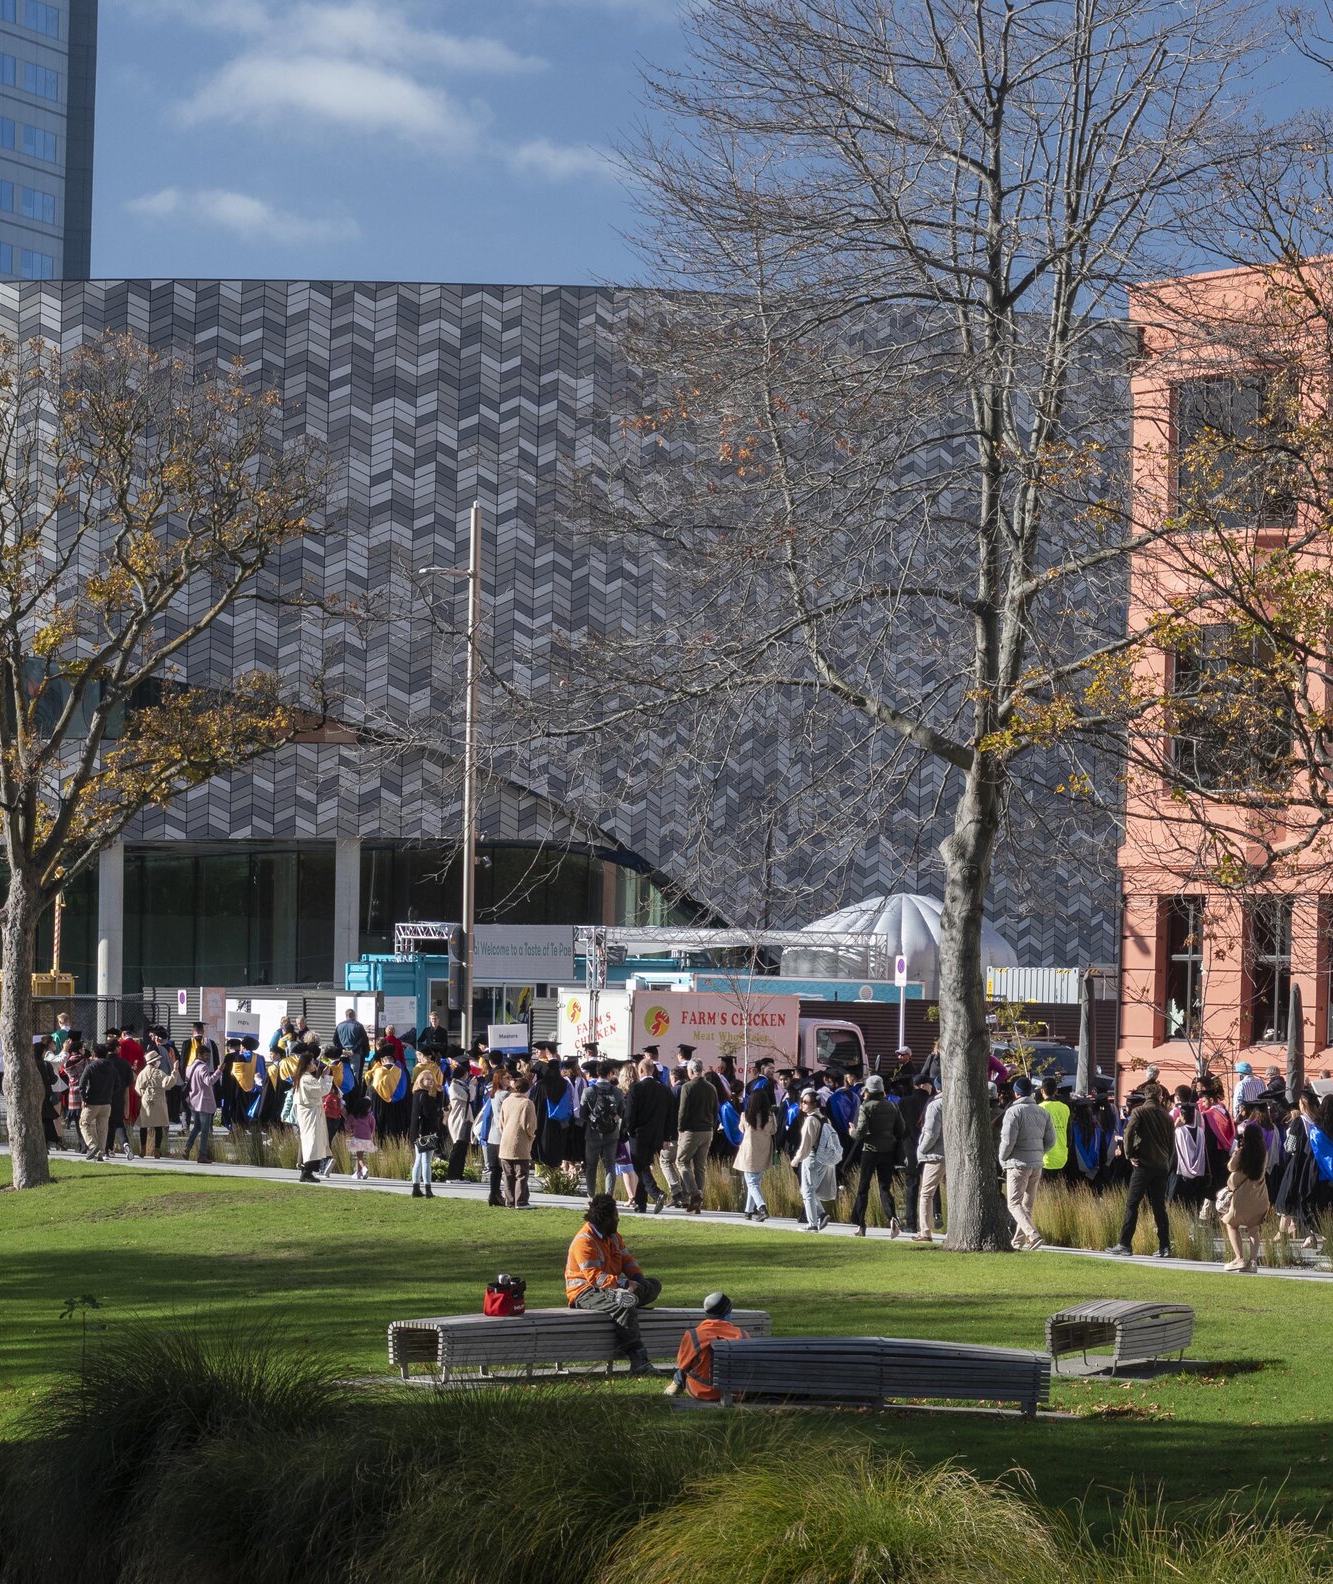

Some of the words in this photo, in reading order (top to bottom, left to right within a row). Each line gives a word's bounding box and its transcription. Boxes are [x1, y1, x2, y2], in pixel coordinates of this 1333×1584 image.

[480, 942, 509, 956] Welcome
[510, 943, 518, 956] to
[518, 947, 524, 956] a
[524, 942, 541, 956] Taste
[542, 942, 551, 956] of
[551, 942, 558, 956] Te
[681, 1010, 728, 1025] FARM'S
[731, 1012, 786, 1027] CHICKEN
[693, 1030, 715, 1041] Meat
